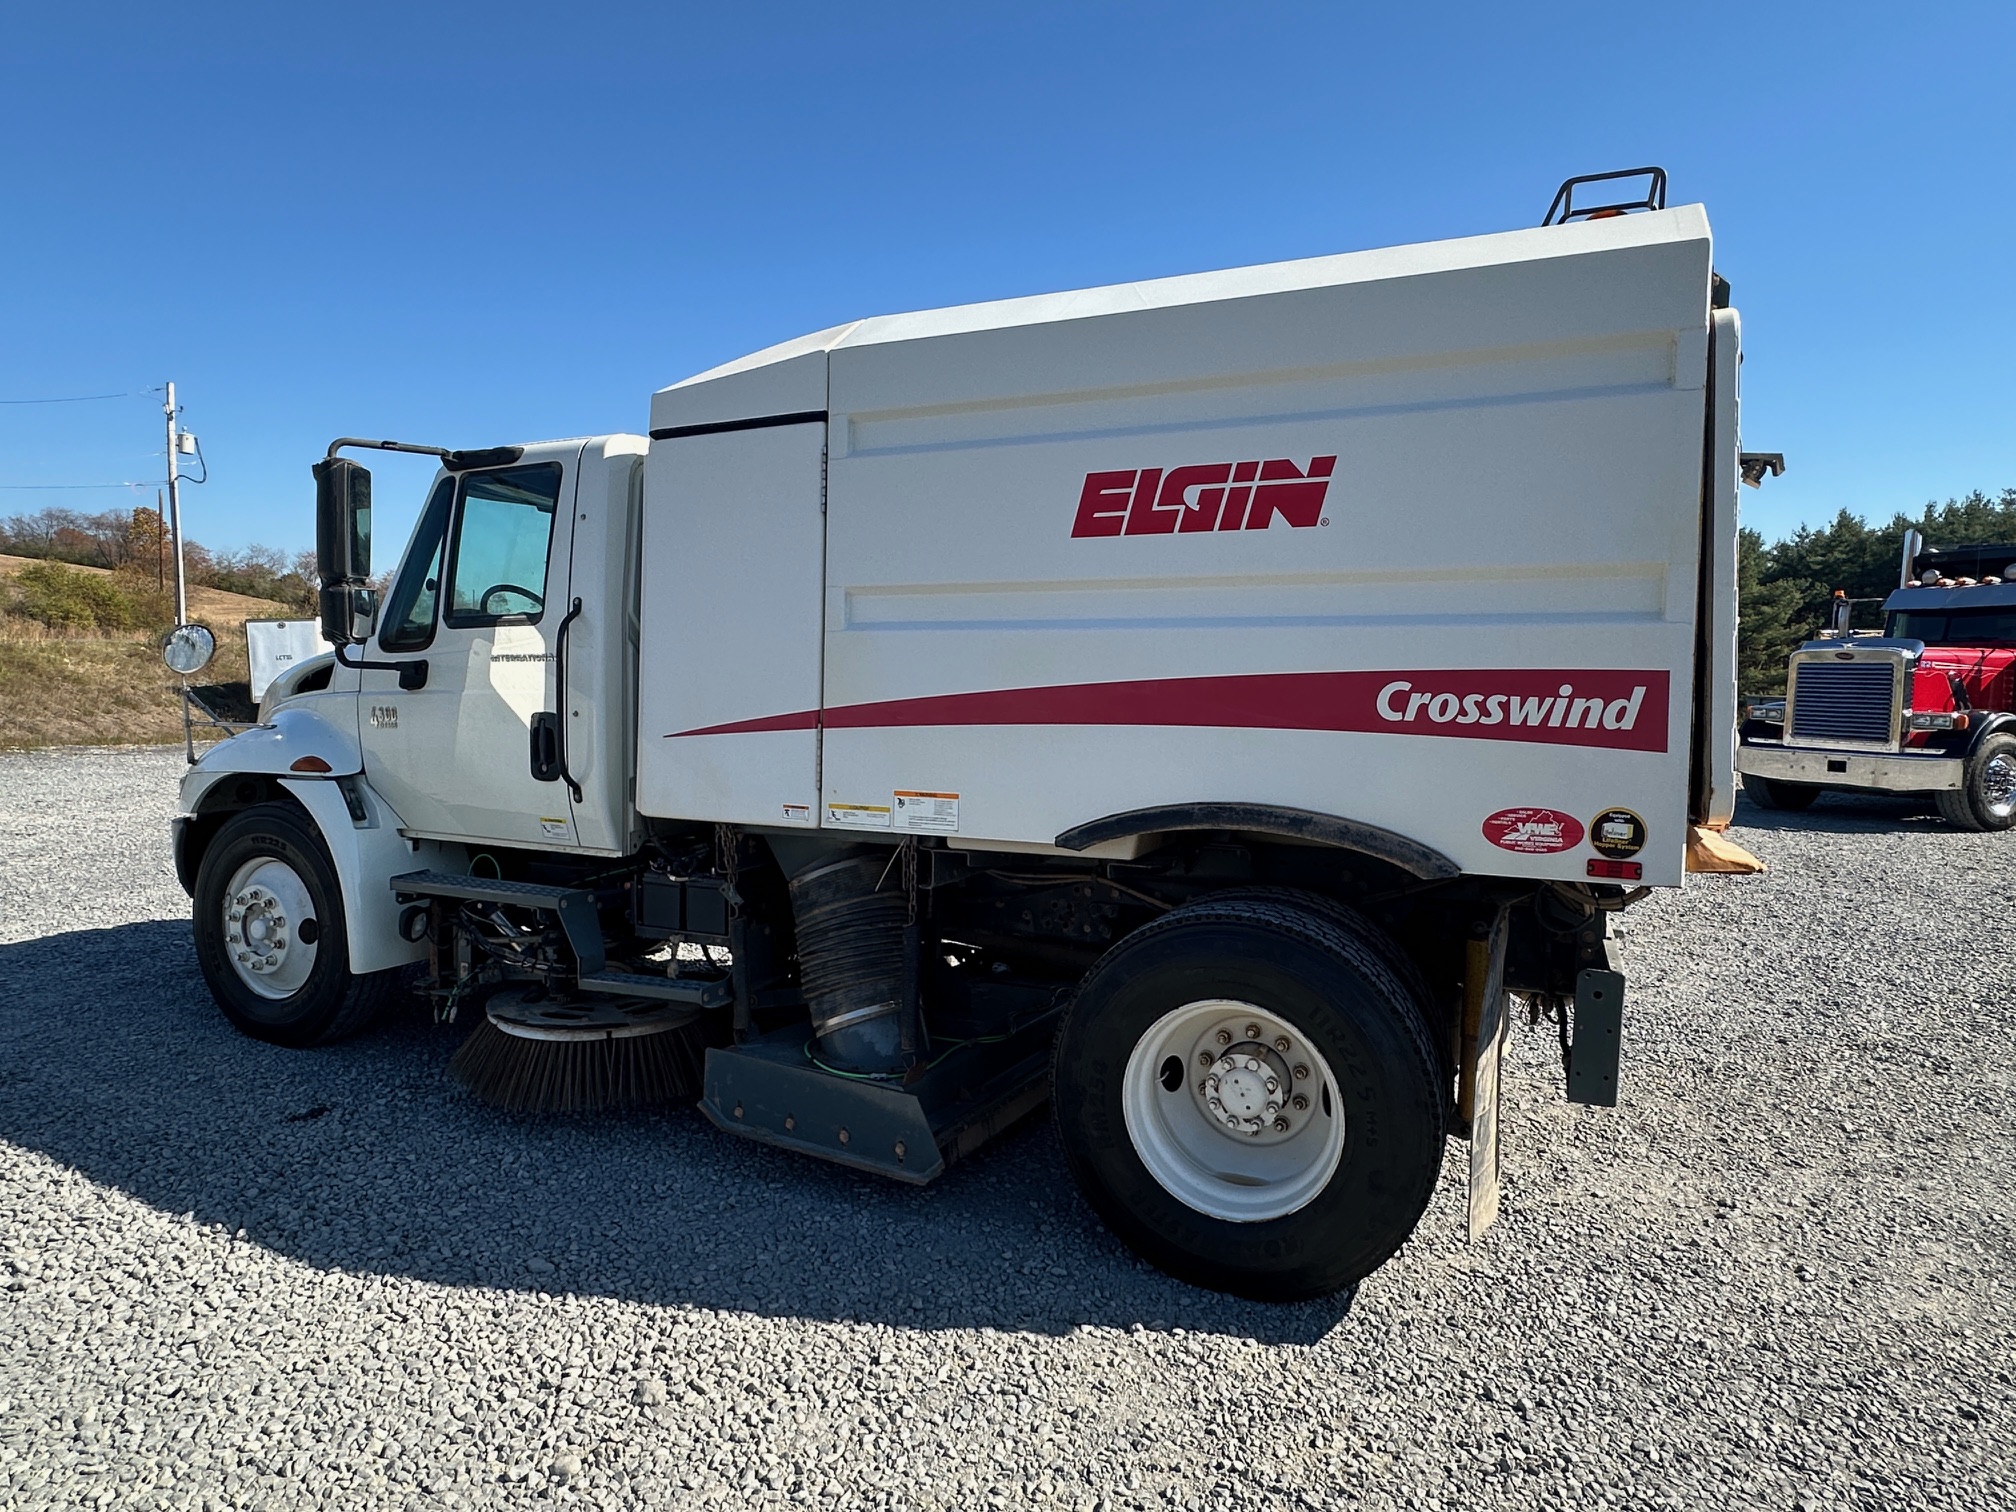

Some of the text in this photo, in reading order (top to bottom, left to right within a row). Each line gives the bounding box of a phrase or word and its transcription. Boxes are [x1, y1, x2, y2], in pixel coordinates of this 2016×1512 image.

[1070, 454, 1338, 539] ELGIN
[490, 653, 557, 662] INTERNATIONA
[1375, 680, 1647, 731] Crosswind
[370, 706, 398, 728] 4300
[1594, 840, 1640, 851] Hopper System
